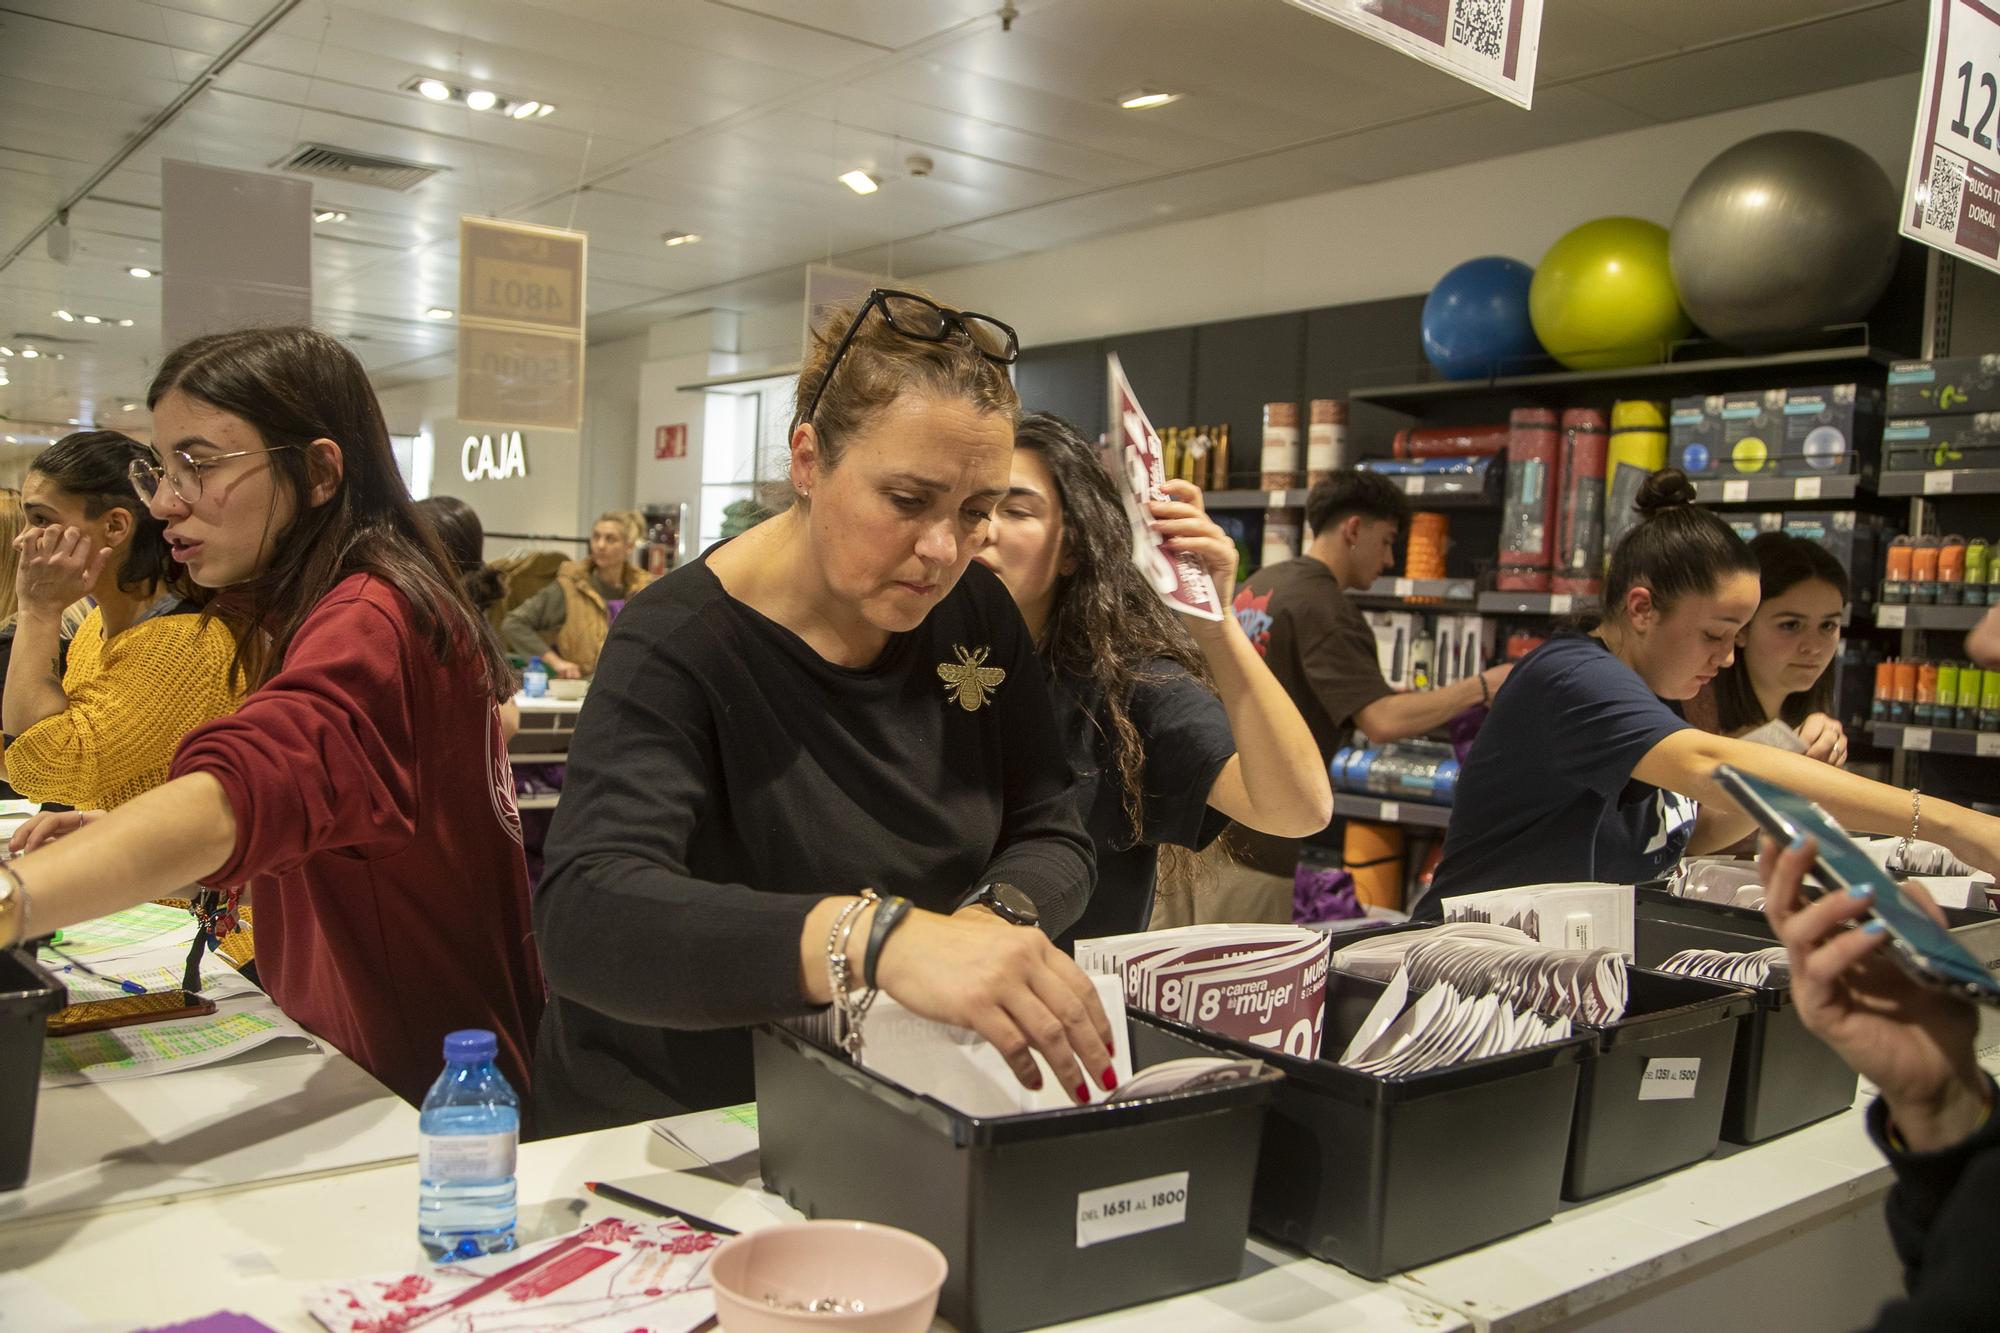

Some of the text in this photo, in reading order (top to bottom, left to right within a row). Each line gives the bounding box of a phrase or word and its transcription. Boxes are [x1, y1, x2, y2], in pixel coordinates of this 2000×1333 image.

[1951, 60, 2000, 158] 12
[1968, 178, 1994, 202] BUSCA
[1967, 203, 1997, 230] DORSAL
[461, 431, 527, 482] CAJA
[1160, 978, 1182, 1013] 8
[1226, 979, 1268, 997] carrera
[1234, 983, 1294, 1025] mujer
[1679, 1069, 1697, 1080] 1500
[1081, 1189, 1186, 1222] DEL 1651 AL 1800
